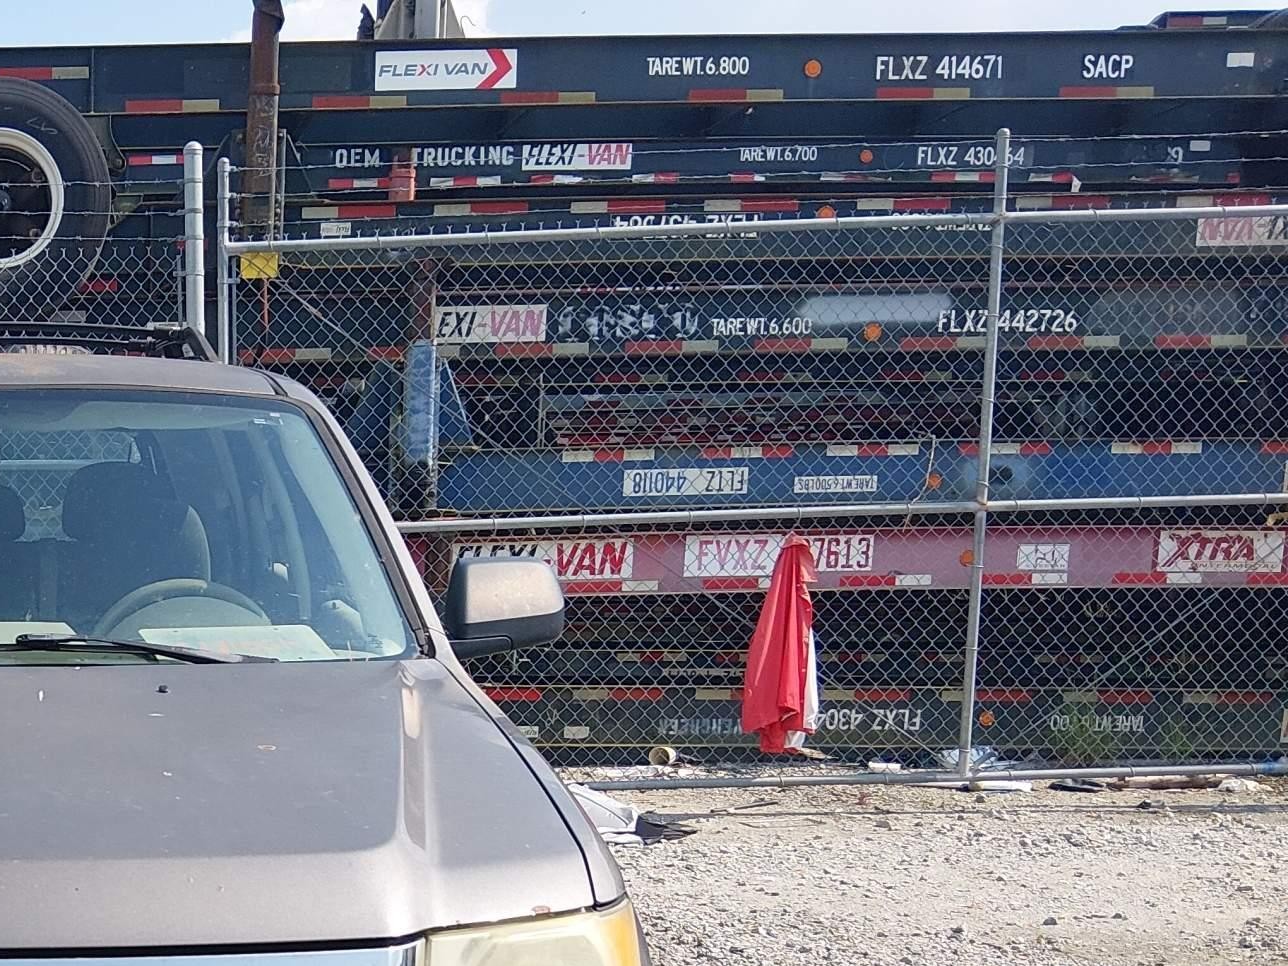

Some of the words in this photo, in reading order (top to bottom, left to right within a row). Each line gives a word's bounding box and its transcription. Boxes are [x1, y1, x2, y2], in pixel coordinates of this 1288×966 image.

[378, 63, 439, 77] FLEXI
[444, 62, 488, 76] VAN
[875, 55, 929, 81] FLXZ
[935, 54, 1003, 80] 414671
[1082, 54, 1134, 79] SACP
[335, 148, 380, 168] OEM
[412, 146, 514, 167] TRUCKING
[917, 147, 958, 166] FLXZ
[964, 147, 1025, 166] 43064
[437, 309, 544, 338] EXI-VAN
[938, 309, 988, 333] FLXZ
[998, 308, 1077, 334] 442726
[805, 537, 871, 569] 7613
